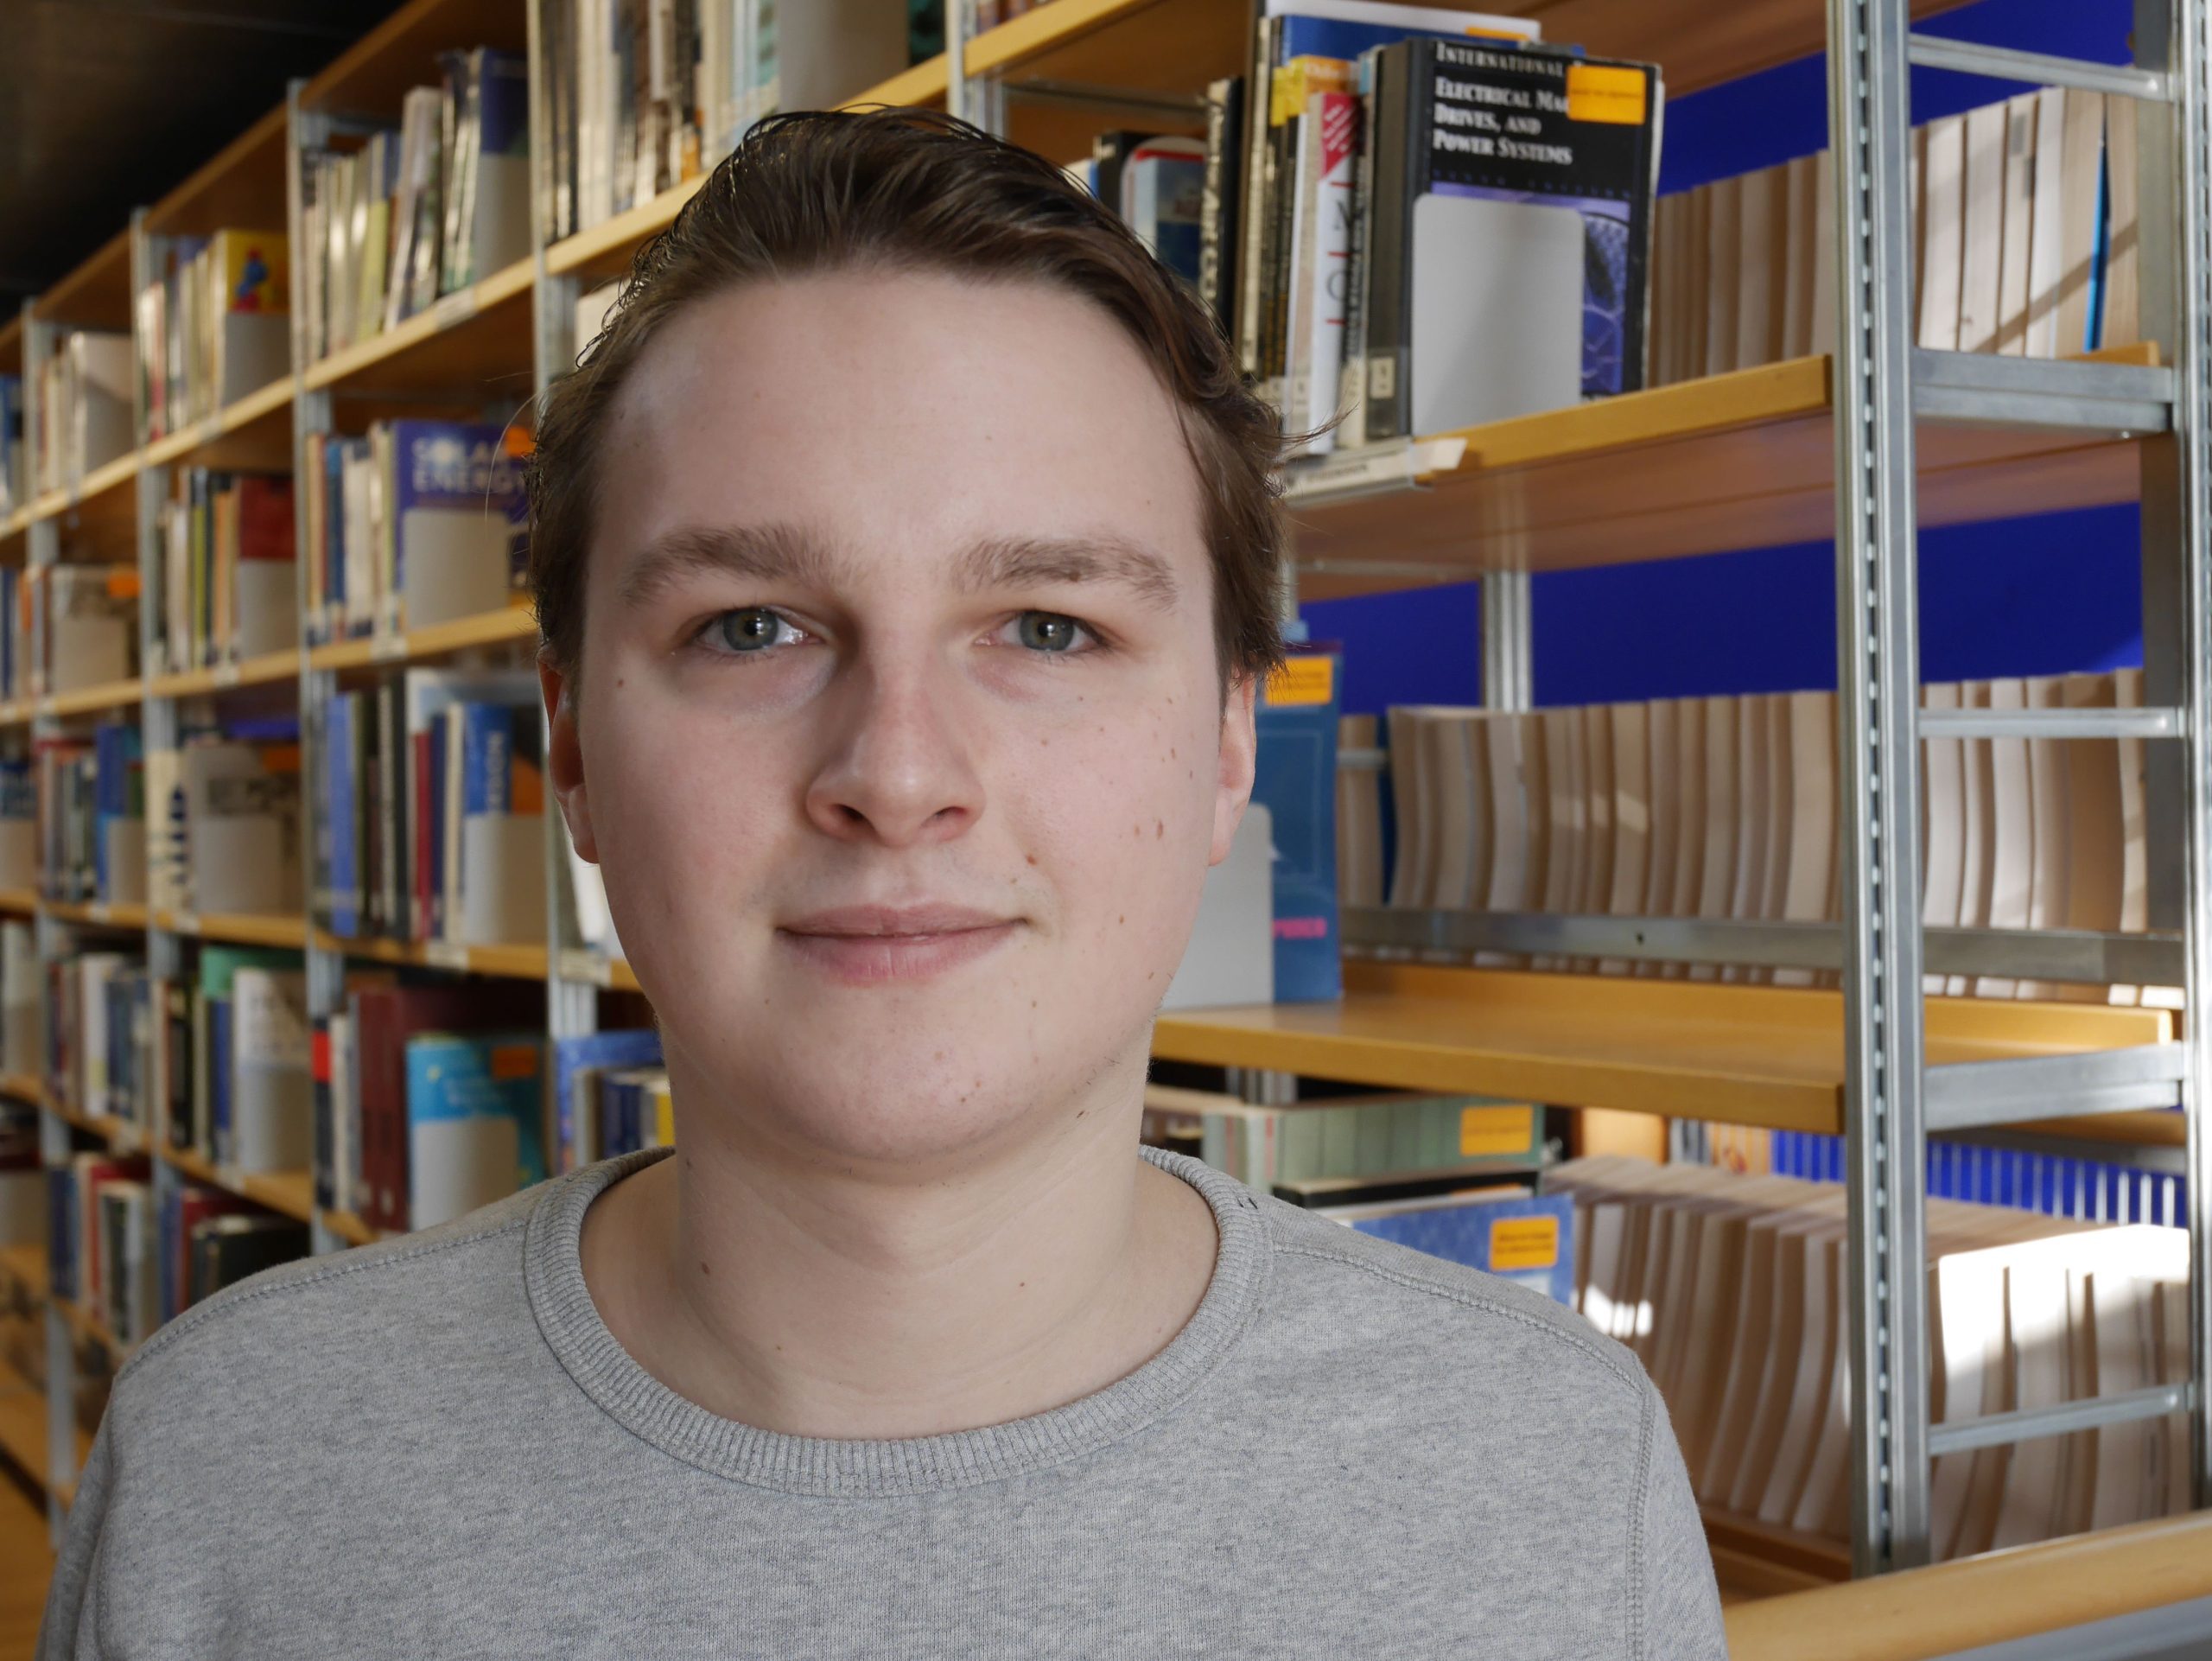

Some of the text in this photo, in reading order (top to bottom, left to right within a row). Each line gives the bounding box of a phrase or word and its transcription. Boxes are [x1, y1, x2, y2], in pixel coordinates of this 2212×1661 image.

[1436, 41, 1564, 78] INTERNATIONAL
[1434, 76, 1532, 110] ELECTRICAL
[1433, 102, 1542, 136] DRIVES, AND
[1432, 128, 1573, 165] POWER SYSTEMS
